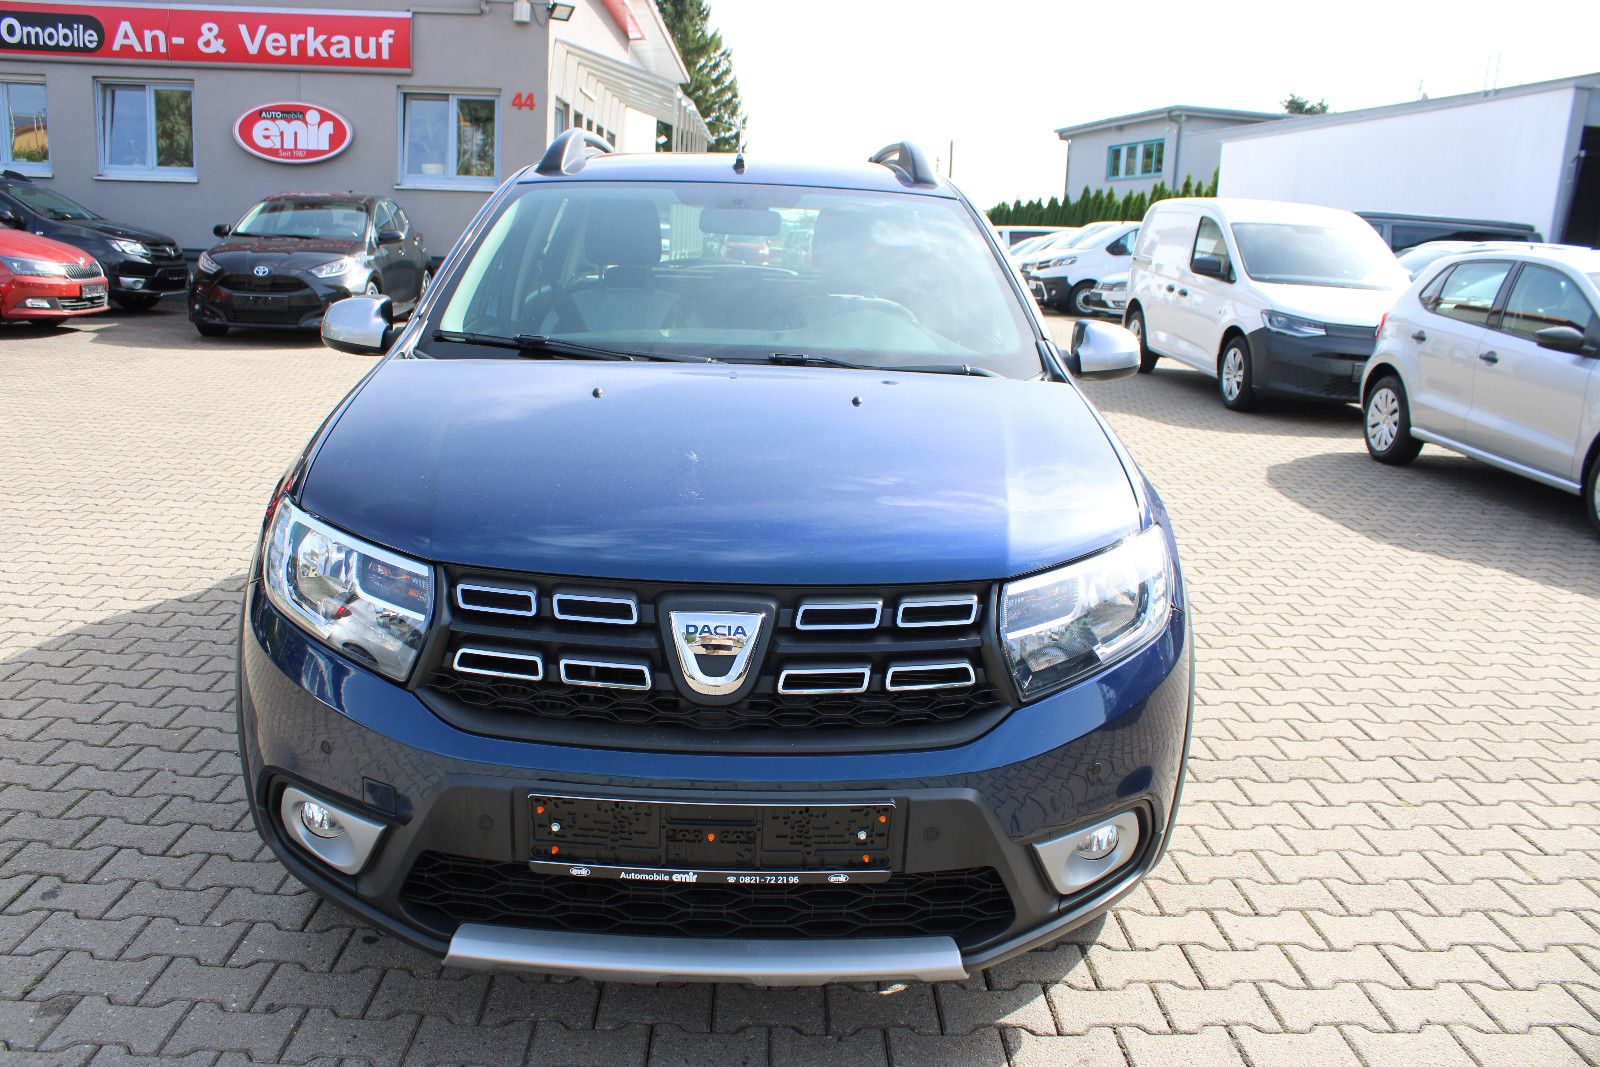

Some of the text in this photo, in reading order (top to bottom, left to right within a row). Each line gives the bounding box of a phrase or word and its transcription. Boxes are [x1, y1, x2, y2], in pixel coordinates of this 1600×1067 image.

[112, 20, 185, 53] An-
[197, 22, 226, 55] &
[238, 24, 395, 60] Verkauf
[511, 91, 535, 111] 44
[252, 109, 334, 151] emir
[685, 624, 748, 637] DACIA
[620, 871, 698, 883] Automobile emir
